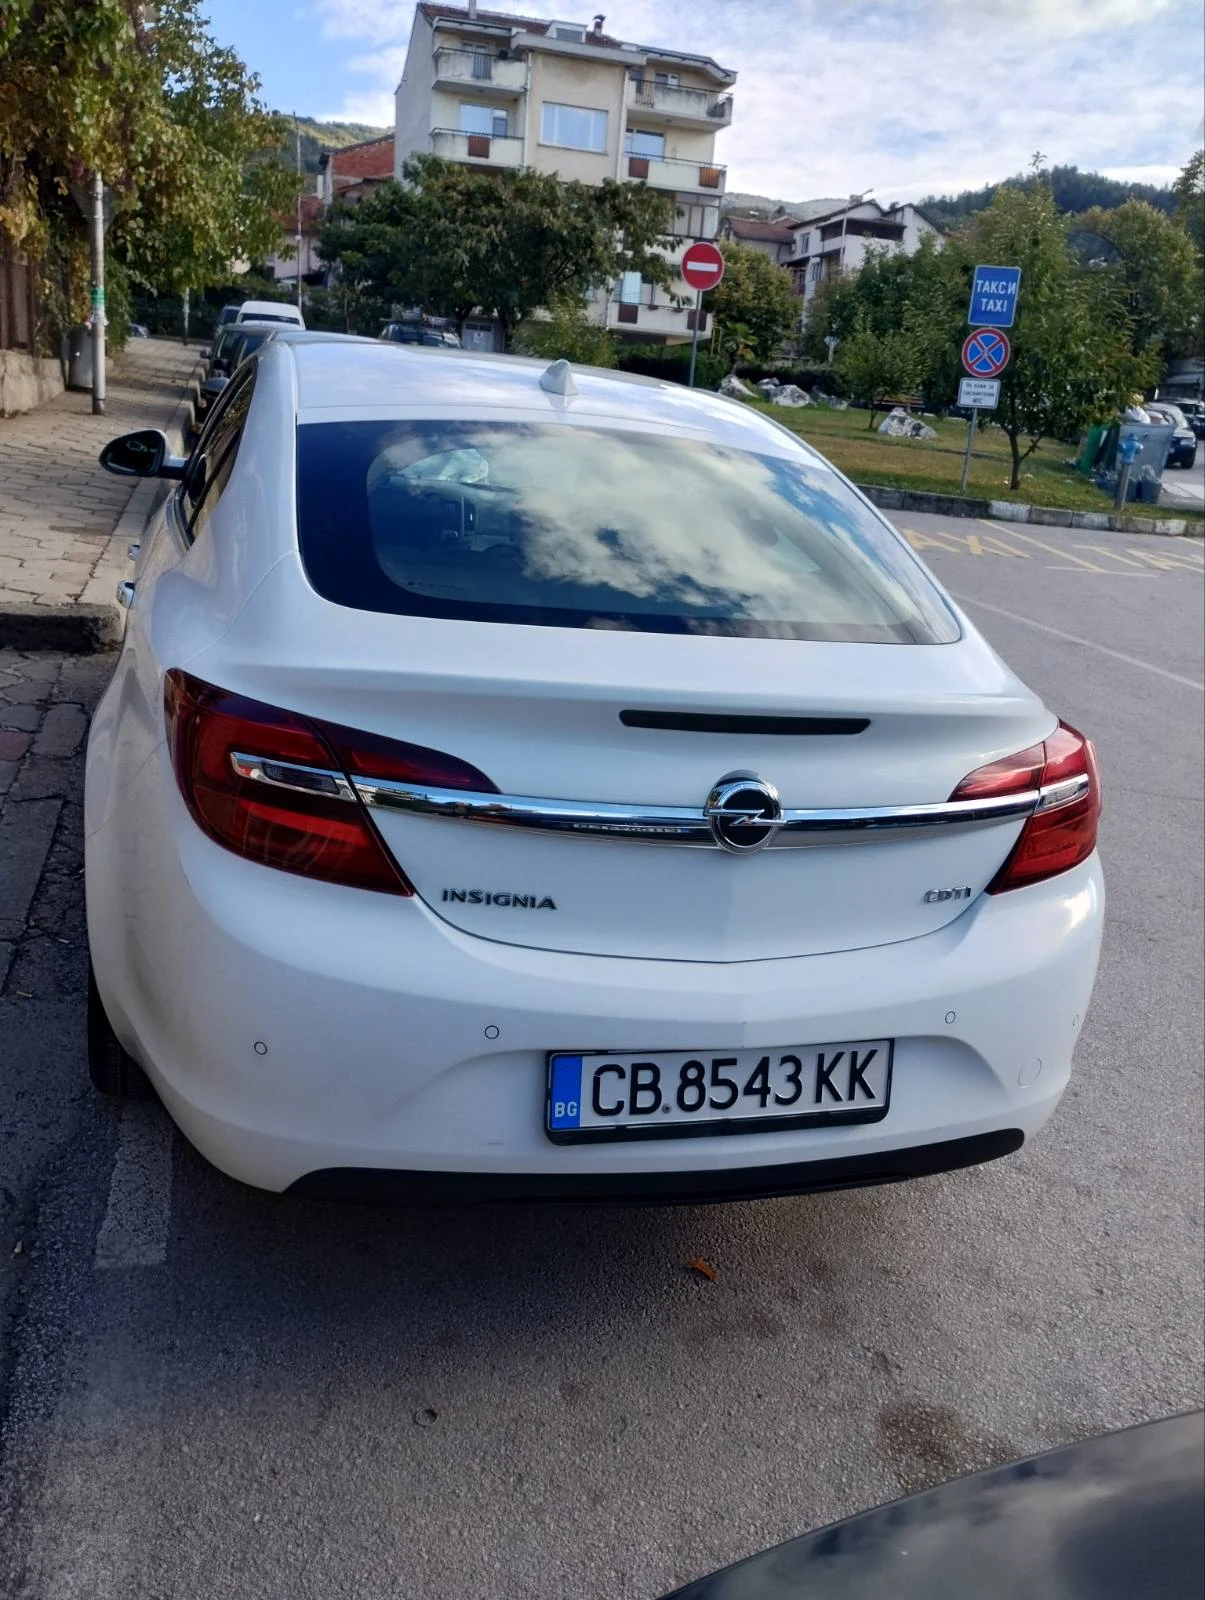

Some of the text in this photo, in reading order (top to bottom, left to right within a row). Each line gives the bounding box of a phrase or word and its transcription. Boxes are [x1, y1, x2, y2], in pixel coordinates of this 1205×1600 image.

[976, 280, 1017, 295] ТАКСИ
[981, 298, 1008, 312] TAXI
[441, 888, 557, 910] INSIGNIA
[592, 1048, 879, 1117] CB 8543 KK
[554, 1101, 578, 1118] BG
